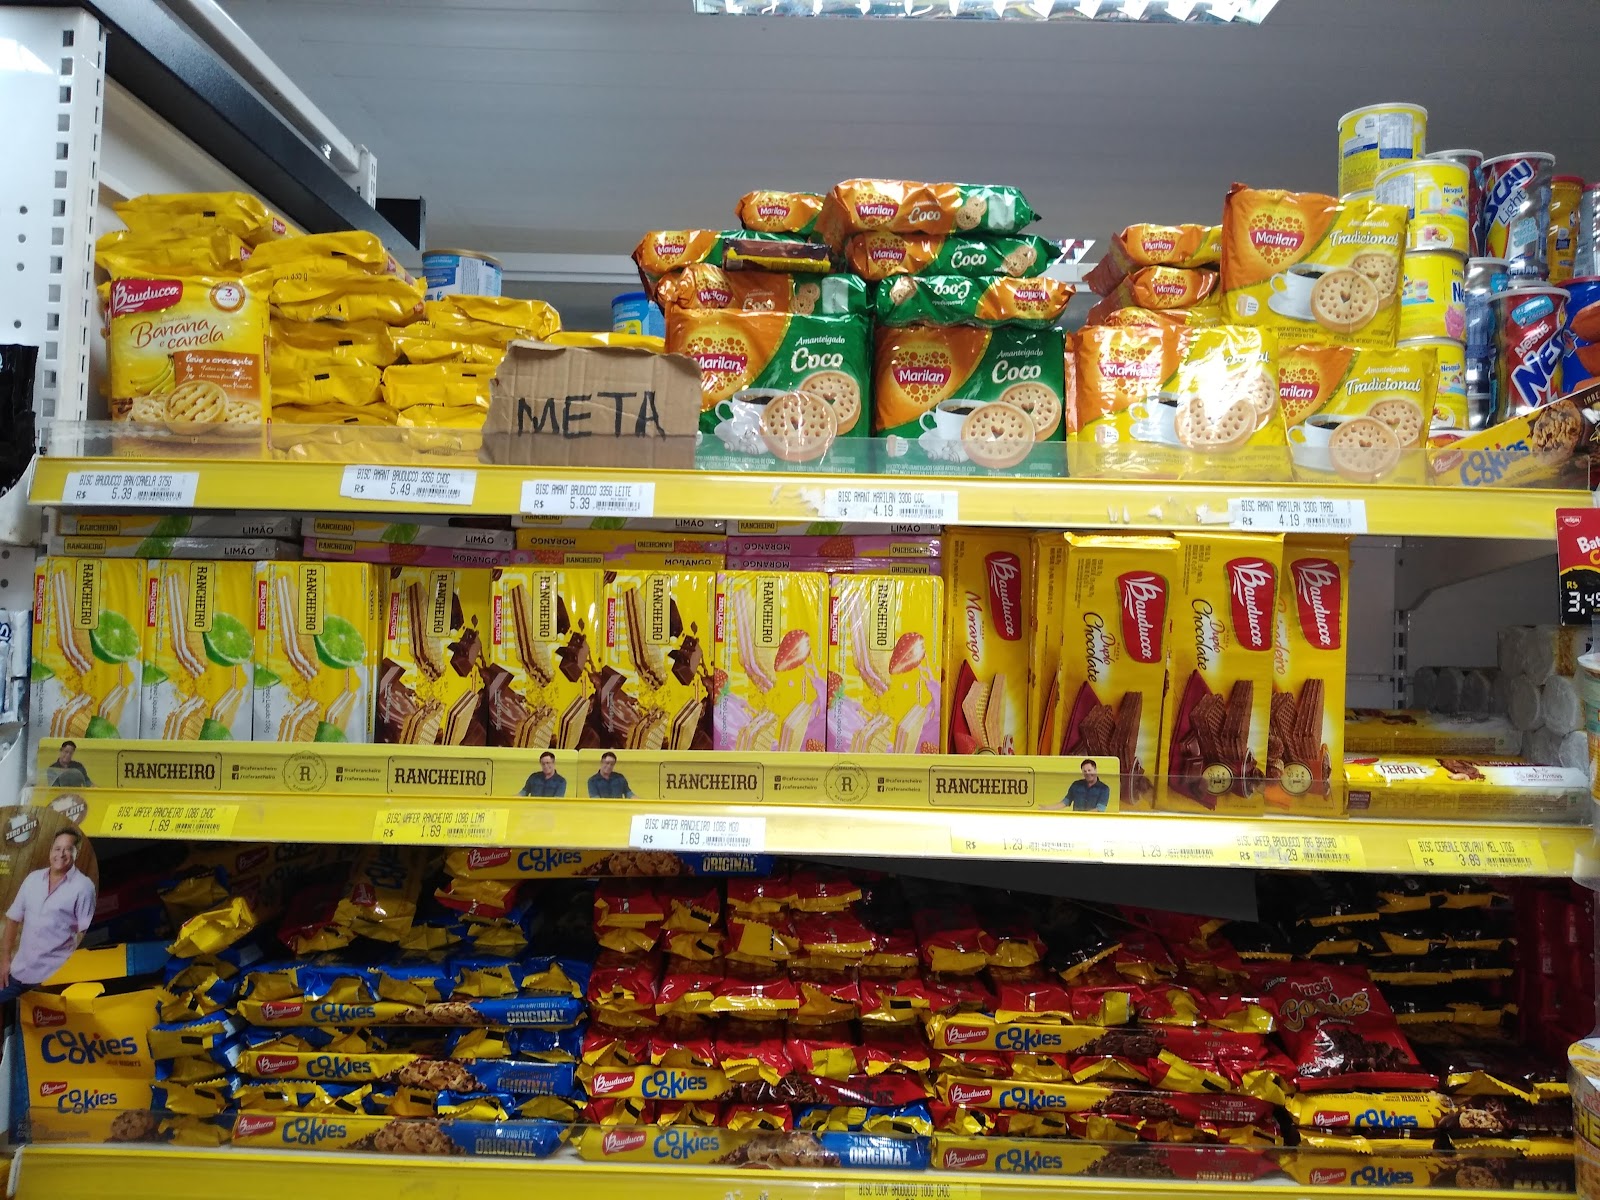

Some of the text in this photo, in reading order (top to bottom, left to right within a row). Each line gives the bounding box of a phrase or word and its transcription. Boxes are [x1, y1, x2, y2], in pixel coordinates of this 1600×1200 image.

[758, 206, 790, 217] Marilan
[858, 204, 896, 217] Marilan
[908, 207, 941, 225] Coco
[1498, 190, 1527, 225] Light
[1144, 240, 1172, 251] Marilan
[1255, 230, 1299, 249] Marilan
[1329, 230, 1399, 248] Tradicional
[872, 249, 903, 260] Marilan
[951, 250, 987, 269] Coco
[112, 281, 179, 313] Bauducco
[933, 279, 970, 299] Coco
[1155, 285, 1184, 296] Marilan
[130, 322, 210, 349] Banana
[159, 326, 225, 349] e canela
[794, 335, 846, 346] Amanteigado
[1514, 321, 1551, 359] Nestlé
[186, 353, 204, 363] leve
[790, 350, 844, 372] Coco
[996, 348, 1044, 359] Amanteigado
[697, 355, 743, 372] Marilan
[899, 368, 945, 384] Marilan
[991, 364, 1042, 385] Coco
[1345, 377, 1422, 393] Tradicional
[517, 391, 666, 442] META
[78, 474, 94, 486] BISC
[157, 475, 173, 487] 375G
[356, 468, 372, 480] BISC
[436, 472, 451, 485] CHOC
[75, 487, 133, 500] R$ 5.39
[354, 483, 411, 496] R$ 5.49
[535, 483, 550, 495] BISC
[570, 484, 597, 497] BAUDUCCO
[599, 485, 613, 497] 335G
[614, 486, 632, 497] LEITE
[838, 490, 852, 503] BISC
[533, 496, 591, 510] R$ 5.39
[873, 504, 894, 517] 4.19
[1241, 500, 1255, 512] BISC
[1303, 501, 1317, 513] 330G
[675, 519, 704, 528] LIMÃO
[740, 522, 921, 534] RANCHEIRO LIMÃO
[1242, 513, 1300, 527] R$ 4.19
[242, 525, 274, 535] LIMÃO
[316, 521, 495, 544] RANCHEIRO LIMÃO
[66, 542, 255, 556] RANCHEIRO LIMÃO
[530, 537, 576, 546] MORANGO
[743, 542, 791, 551] MORANGO
[317, 541, 498, 564] RANCHEIRO MORANGO
[742, 560, 790, 569] MORANGO
[80, 563, 95, 626] RANCHEIRO
[1566, 581, 1578, 590] R$
[193, 566, 209, 629] RANCHEIRO
[305, 568, 318, 632] RANCHEIRO
[432, 574, 448, 634] RANCHEIRO
[990, 556, 1016, 637] Bauducco
[1233, 561, 1272, 648] Bauducco
[1298, 561, 1336, 647] Bauducco
[652, 578, 664, 642] RANCHEIRO
[763, 581, 774, 644] RANCHEIRO
[1125, 576, 1164, 660] Bauducco
[965, 590, 982, 663] Morango
[1191, 598, 1214, 672] Chocolate
[1083, 611, 1105, 684] Chocolate
[124, 762, 216, 781] RANCHEIRO
[394, 766, 487, 788] RANCHEIRO
[666, 773, 758, 790] RANCHEIRO
[935, 777, 1029, 796] RANCHEIRO
[117, 805, 133, 818] BISC
[134, 806, 152, 819] WAFER
[153, 806, 183, 819] RANCHEIRO
[200, 807, 215, 820] CHOC
[386, 812, 400, 824] BISC
[402, 812, 420, 824] WAFER
[422, 812, 453, 825] RANCHEIRO
[470, 812, 486, 824] LIMA
[6, 820, 38, 841] ZERO LEITE
[112, 819, 170, 832] R$ 1.69
[383, 825, 442, 838] R$ 1.69
[644, 818, 659, 830] BISC
[661, 819, 679, 831] WAFER
[642, 832, 701, 845] R$ 1.69
[965, 837, 1023, 851] R$ 1.29
[1418, 841, 1434, 853] BISC
[469, 848, 582, 872] Bauducco Cookies
[702, 856, 757, 873] ORIGINAL
[1239, 851, 1251, 861] R$
[1423, 854, 1481, 867] R$ 3.89
[262, 1002, 377, 1023] Bauducco Cookies
[506, 1008, 569, 1023] ORIGINAL
[40, 1027, 139, 1066] Cookies
[945, 1027, 1063, 1051] Bauducco Cookies
[257, 1055, 372, 1080] Bauducco Cookies
[594, 1069, 708, 1100] Bauducco Cookies
[57, 1088, 118, 1115] Cookies
[950, 1085, 1067, 1112] Bauducco Cookies
[1314, 1112, 1349, 1126] Bauducco
[236, 1117, 347, 1146] Bauducco Cookies
[474, 1137, 537, 1157] ORIGINAL
[604, 1128, 720, 1160] Bauducco Cookies
[850, 1146, 911, 1166] ORIGINAL
[943, 1149, 1063, 1173] Bauducco Cookies
